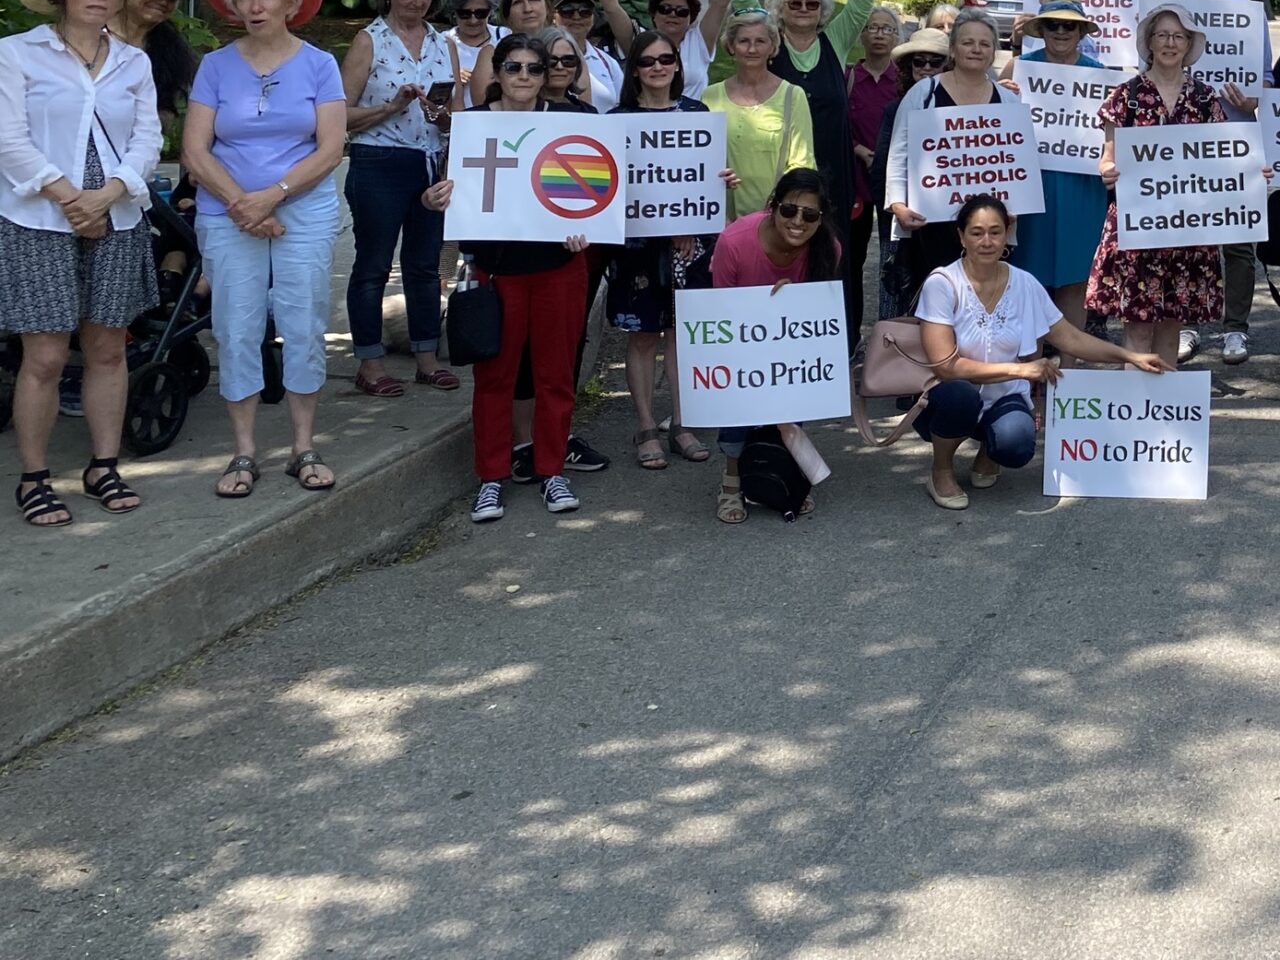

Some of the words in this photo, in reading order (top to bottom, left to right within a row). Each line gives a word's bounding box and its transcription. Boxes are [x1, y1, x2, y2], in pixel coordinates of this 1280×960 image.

[1086, 12, 1120, 24] ools
[1193, 12, 1251, 29] NEED
[1027, 76, 1065, 96] We
[945, 115, 1002, 132] Make
[1030, 107, 1102, 129] Spiritu
[640, 130, 712, 149] NEED
[922, 131, 1024, 152] CATHOLIC
[1131, 143, 1174, 162] We
[1182, 139, 1250, 160] NEED
[935, 150, 1016, 169] Schools
[628, 163, 705, 184] iritual
[921, 167, 1028, 189] CATHOLIC
[1140, 172, 1245, 200] Spiritual
[625, 196, 720, 220] dership
[1125, 205, 1262, 231] Leadership
[683, 319, 734, 345] YES
[739, 322, 767, 343] to
[772, 316, 840, 341] Jesus
[692, 365, 731, 390] NO
[737, 367, 765, 389] to
[770, 356, 834, 386] Pride
[1055, 398, 1102, 420] YES
[1107, 401, 1132, 421] to
[1136, 399, 1202, 422] Jesus
[1060, 439, 1098, 462] NO
[1103, 442, 1128, 462] to
[1133, 440, 1193, 463] Pride
